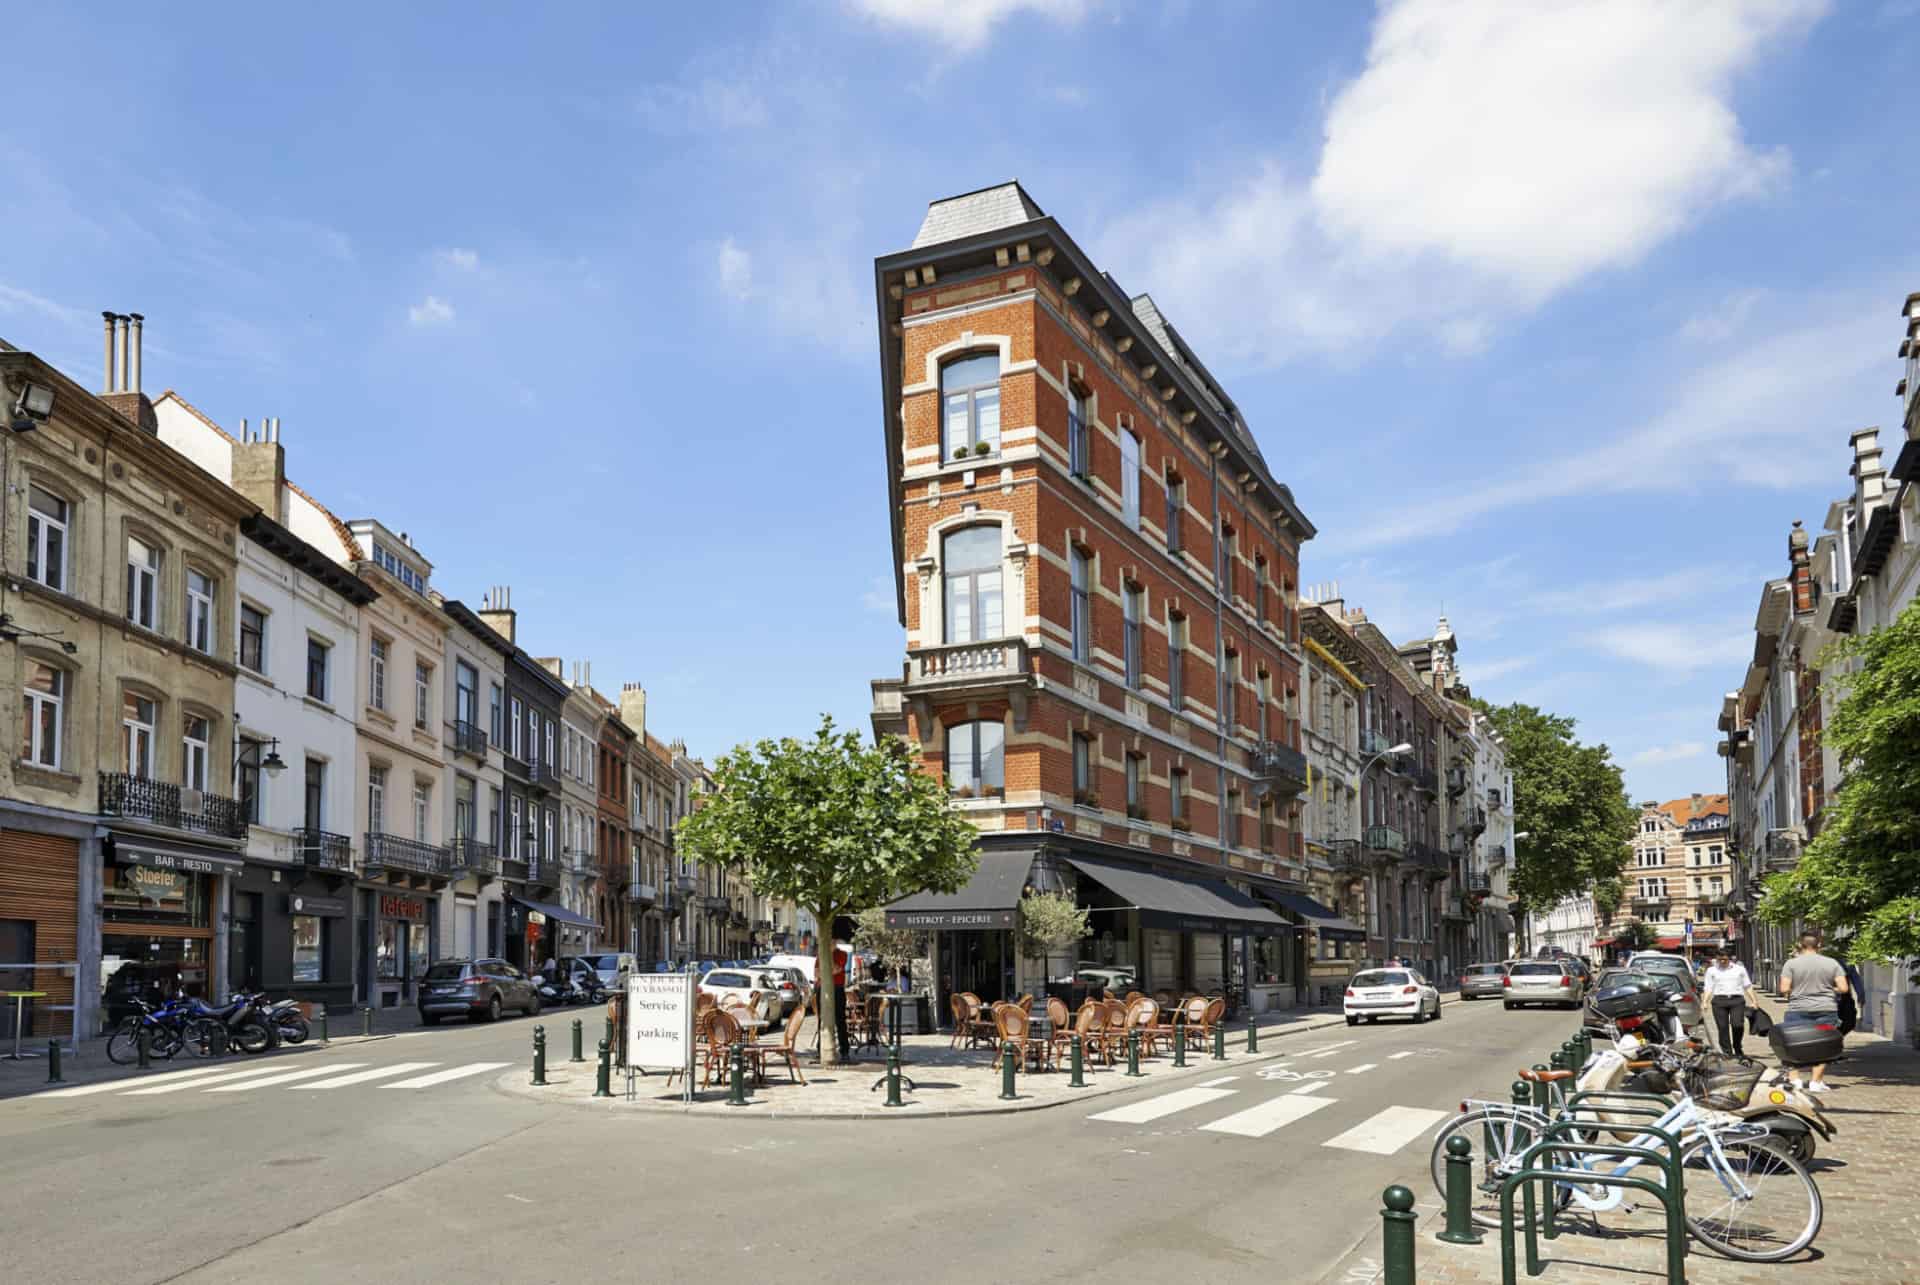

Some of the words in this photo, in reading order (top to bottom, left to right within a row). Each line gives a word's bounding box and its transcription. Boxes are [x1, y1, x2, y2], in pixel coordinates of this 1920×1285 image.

[155, 855, 175, 866] BAR
[183, 859, 212, 872] RESTO
[907, 916, 944, 925] BISTROT
[639, 1000, 678, 1011] Service
[637, 1027, 680, 1041] parking
